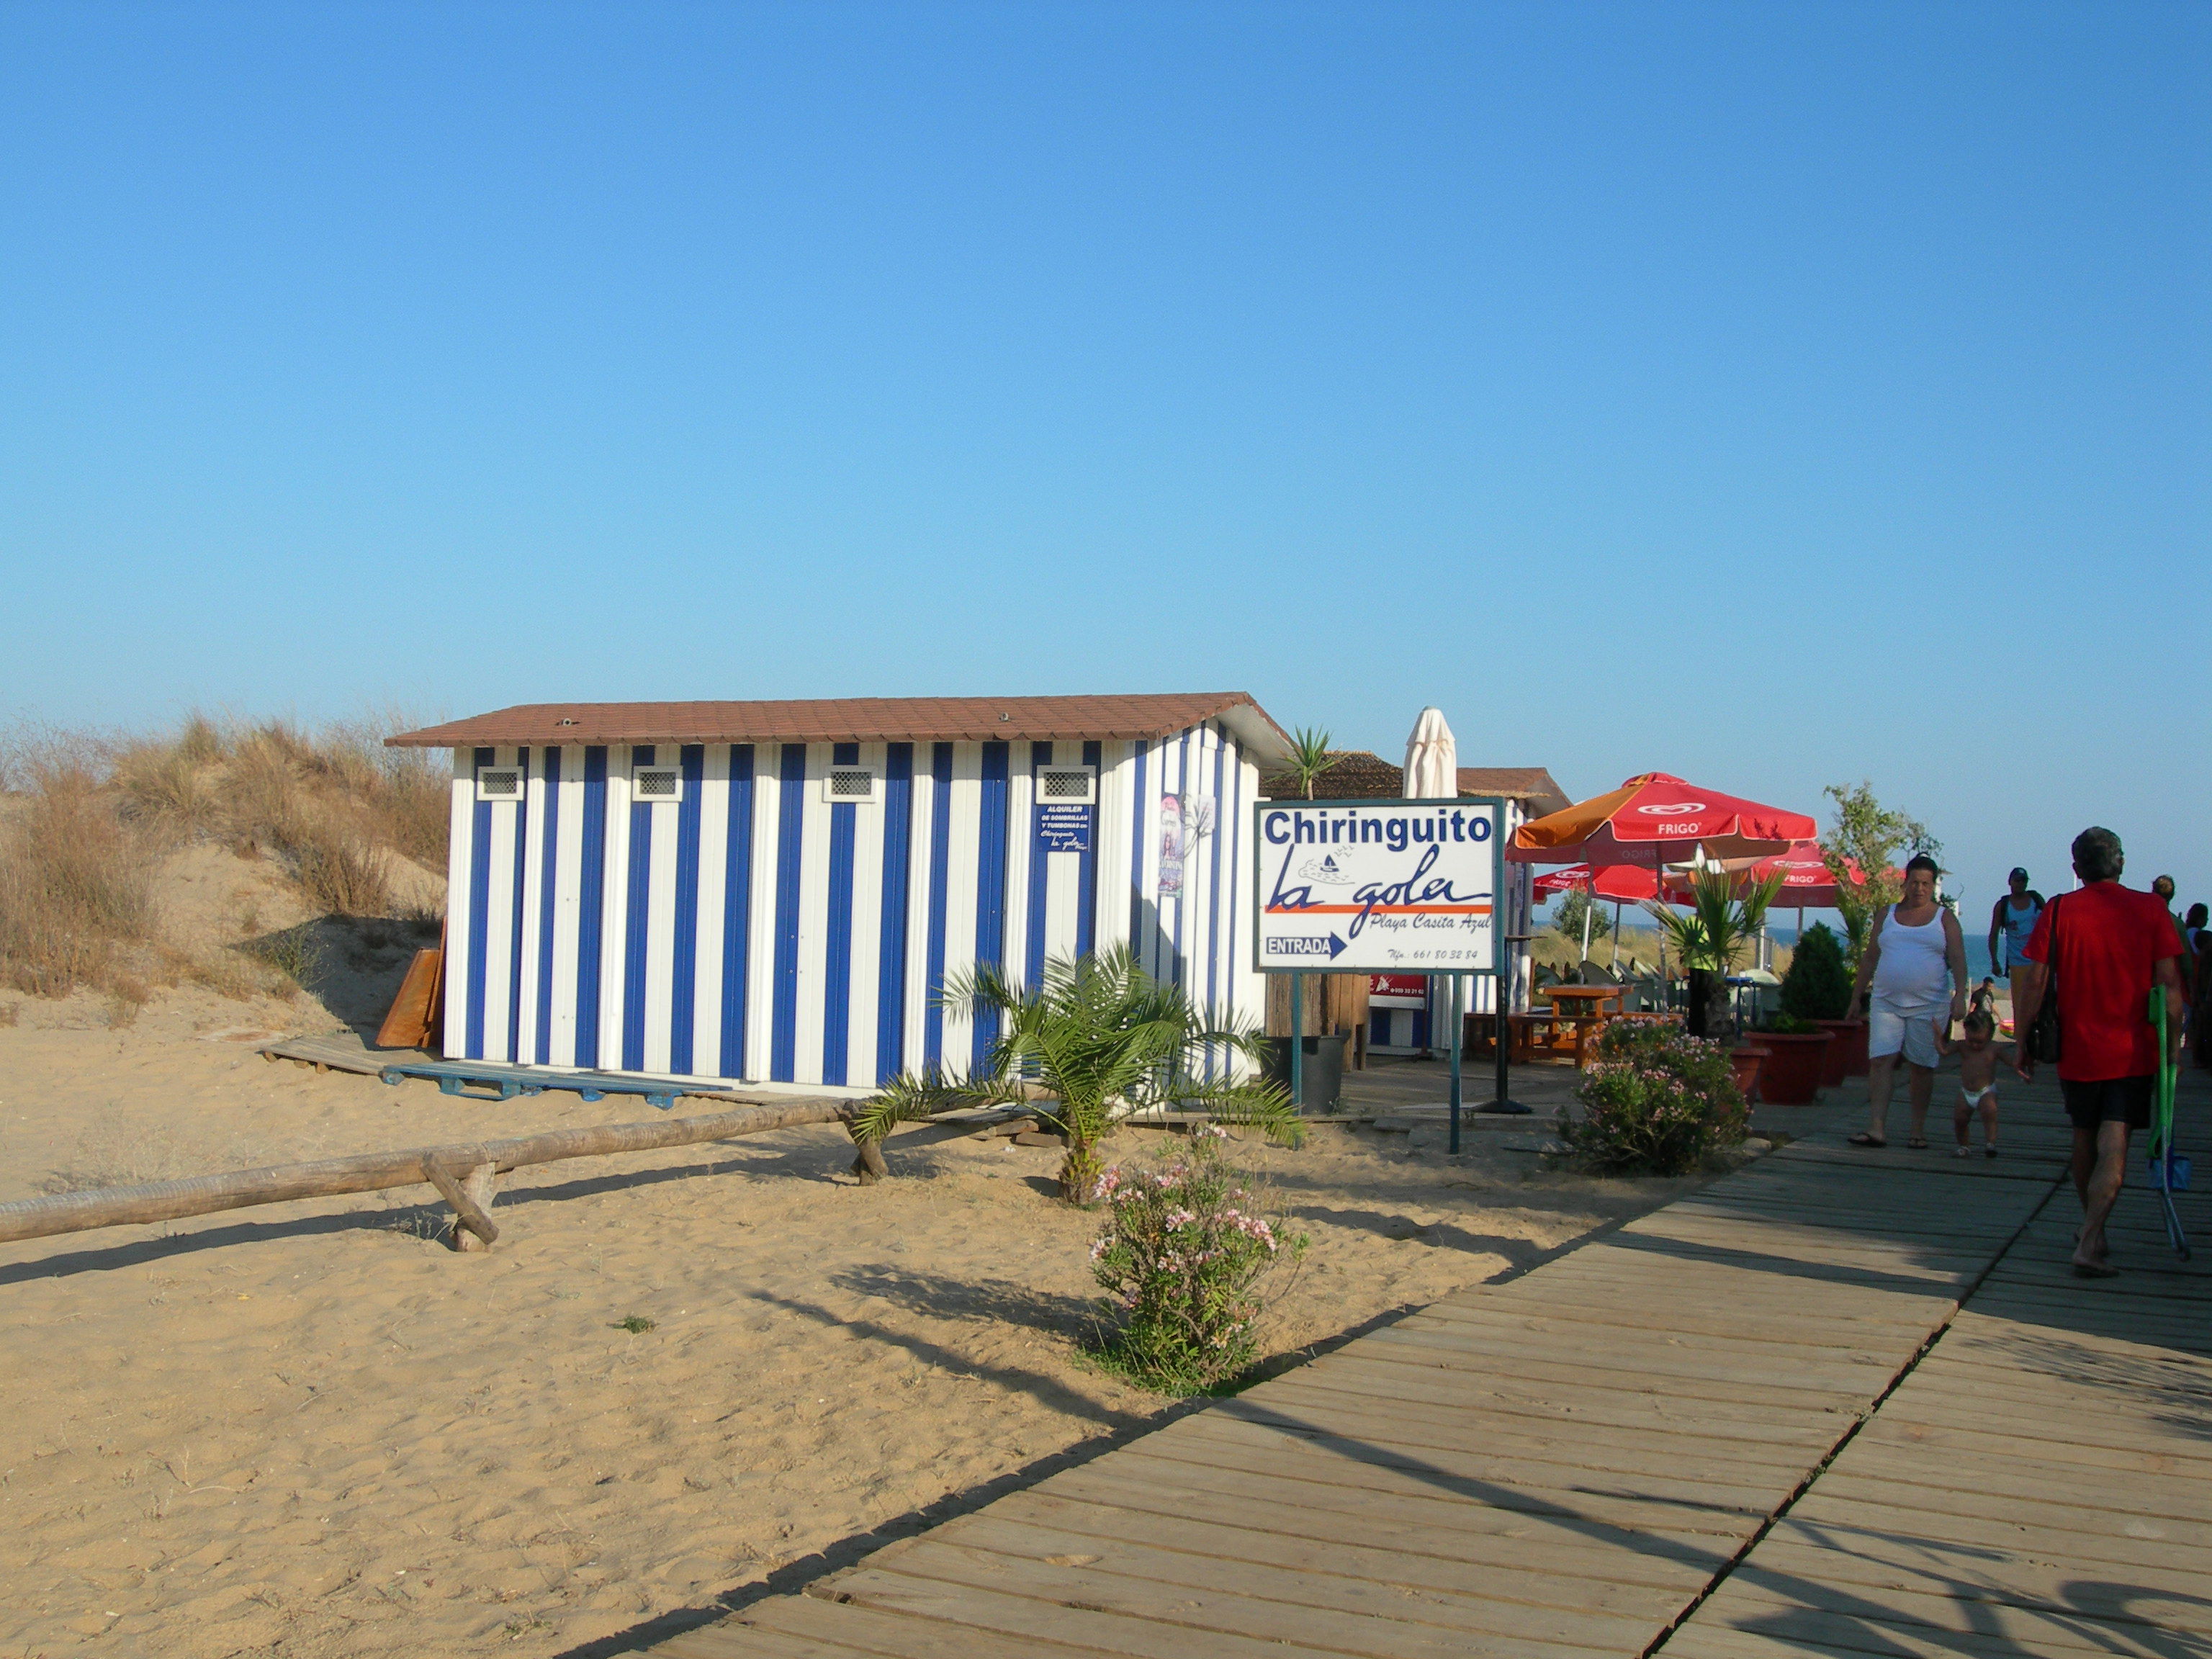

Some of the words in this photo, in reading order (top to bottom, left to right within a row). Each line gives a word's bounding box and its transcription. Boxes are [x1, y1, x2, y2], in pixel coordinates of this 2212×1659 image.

[1265, 809, 1491, 852] Chiringuito
[1658, 823, 1699, 835] FRIGO
[1784, 875, 1815, 884] FRIGO
[1349, 844, 1493, 940] gola
[1370, 913, 1407, 932] Playa
[1413, 912, 1455, 929] Casita
[1460, 913, 1492, 934] Azul
[1268, 938, 1332, 953] ENTRADA
[1413, 950, 1431, 959] 661
[1435, 950, 1447, 959] 80
[1449, 950, 1462, 959] 32
